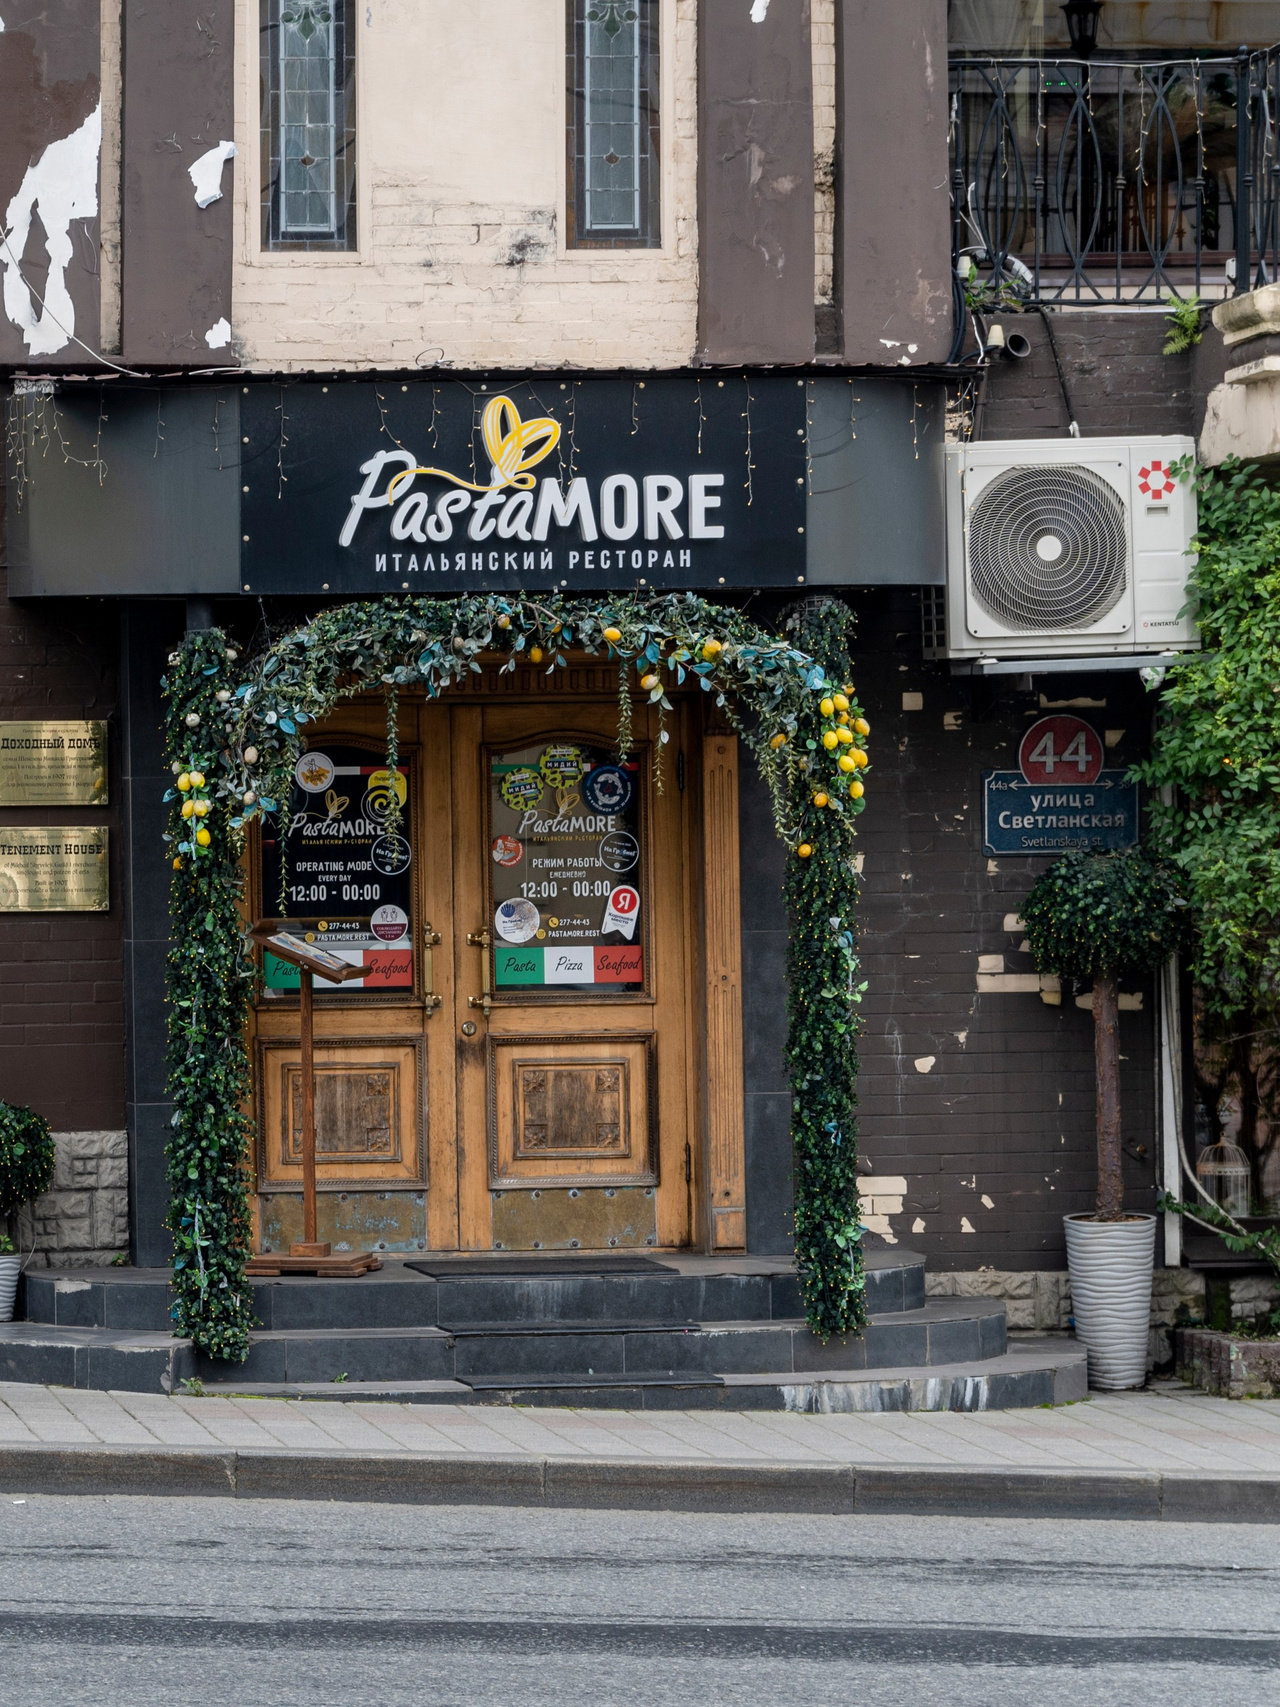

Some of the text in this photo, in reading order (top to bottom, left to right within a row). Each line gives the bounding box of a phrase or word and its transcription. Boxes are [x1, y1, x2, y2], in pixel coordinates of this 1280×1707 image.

[338, 449, 725, 547] PastaMORE
[375, 549, 692, 572] ИТАЛЬЯНСКИЙ РЕСТОРАН
[1, 736, 65, 750] ДОХОДНЫЙ
[1028, 731, 1093, 774] 44
[546, 760, 578, 768] МИДИЙ
[508, 782, 537, 793] МИДИЙ
[1030, 794, 1095, 812] улица
[518, 810, 616, 834] PastaMORE
[998, 810, 1125, 829] Светланская
[0, 844, 102, 855] TENEMENT HOUSE
[1021, 835, 1103, 849] Svetlanskaya st.
[296, 861, 344, 872] OPERATING
[347, 861, 372, 871] MODE
[532, 858, 565, 868] РЕЖИМ
[567, 857, 602, 868] РАБОТЫ
[318, 874, 352, 882] EVERY DAY
[549, 870, 587, 879] ЕЖЕДНЕВНО
[289, 884, 327, 901] 12:00
[342, 883, 380, 901] 00:00
[520, 881, 558, 898] 12:00
[573, 880, 611, 897] 00:00
[617, 892, 631, 910] Я
[273, 960, 301, 976] Past
[369, 958, 412, 979] Seafood
[504, 956, 537, 972] Pasta
[555, 956, 583, 972] Pizza
[597, 954, 643, 976] Seafood
